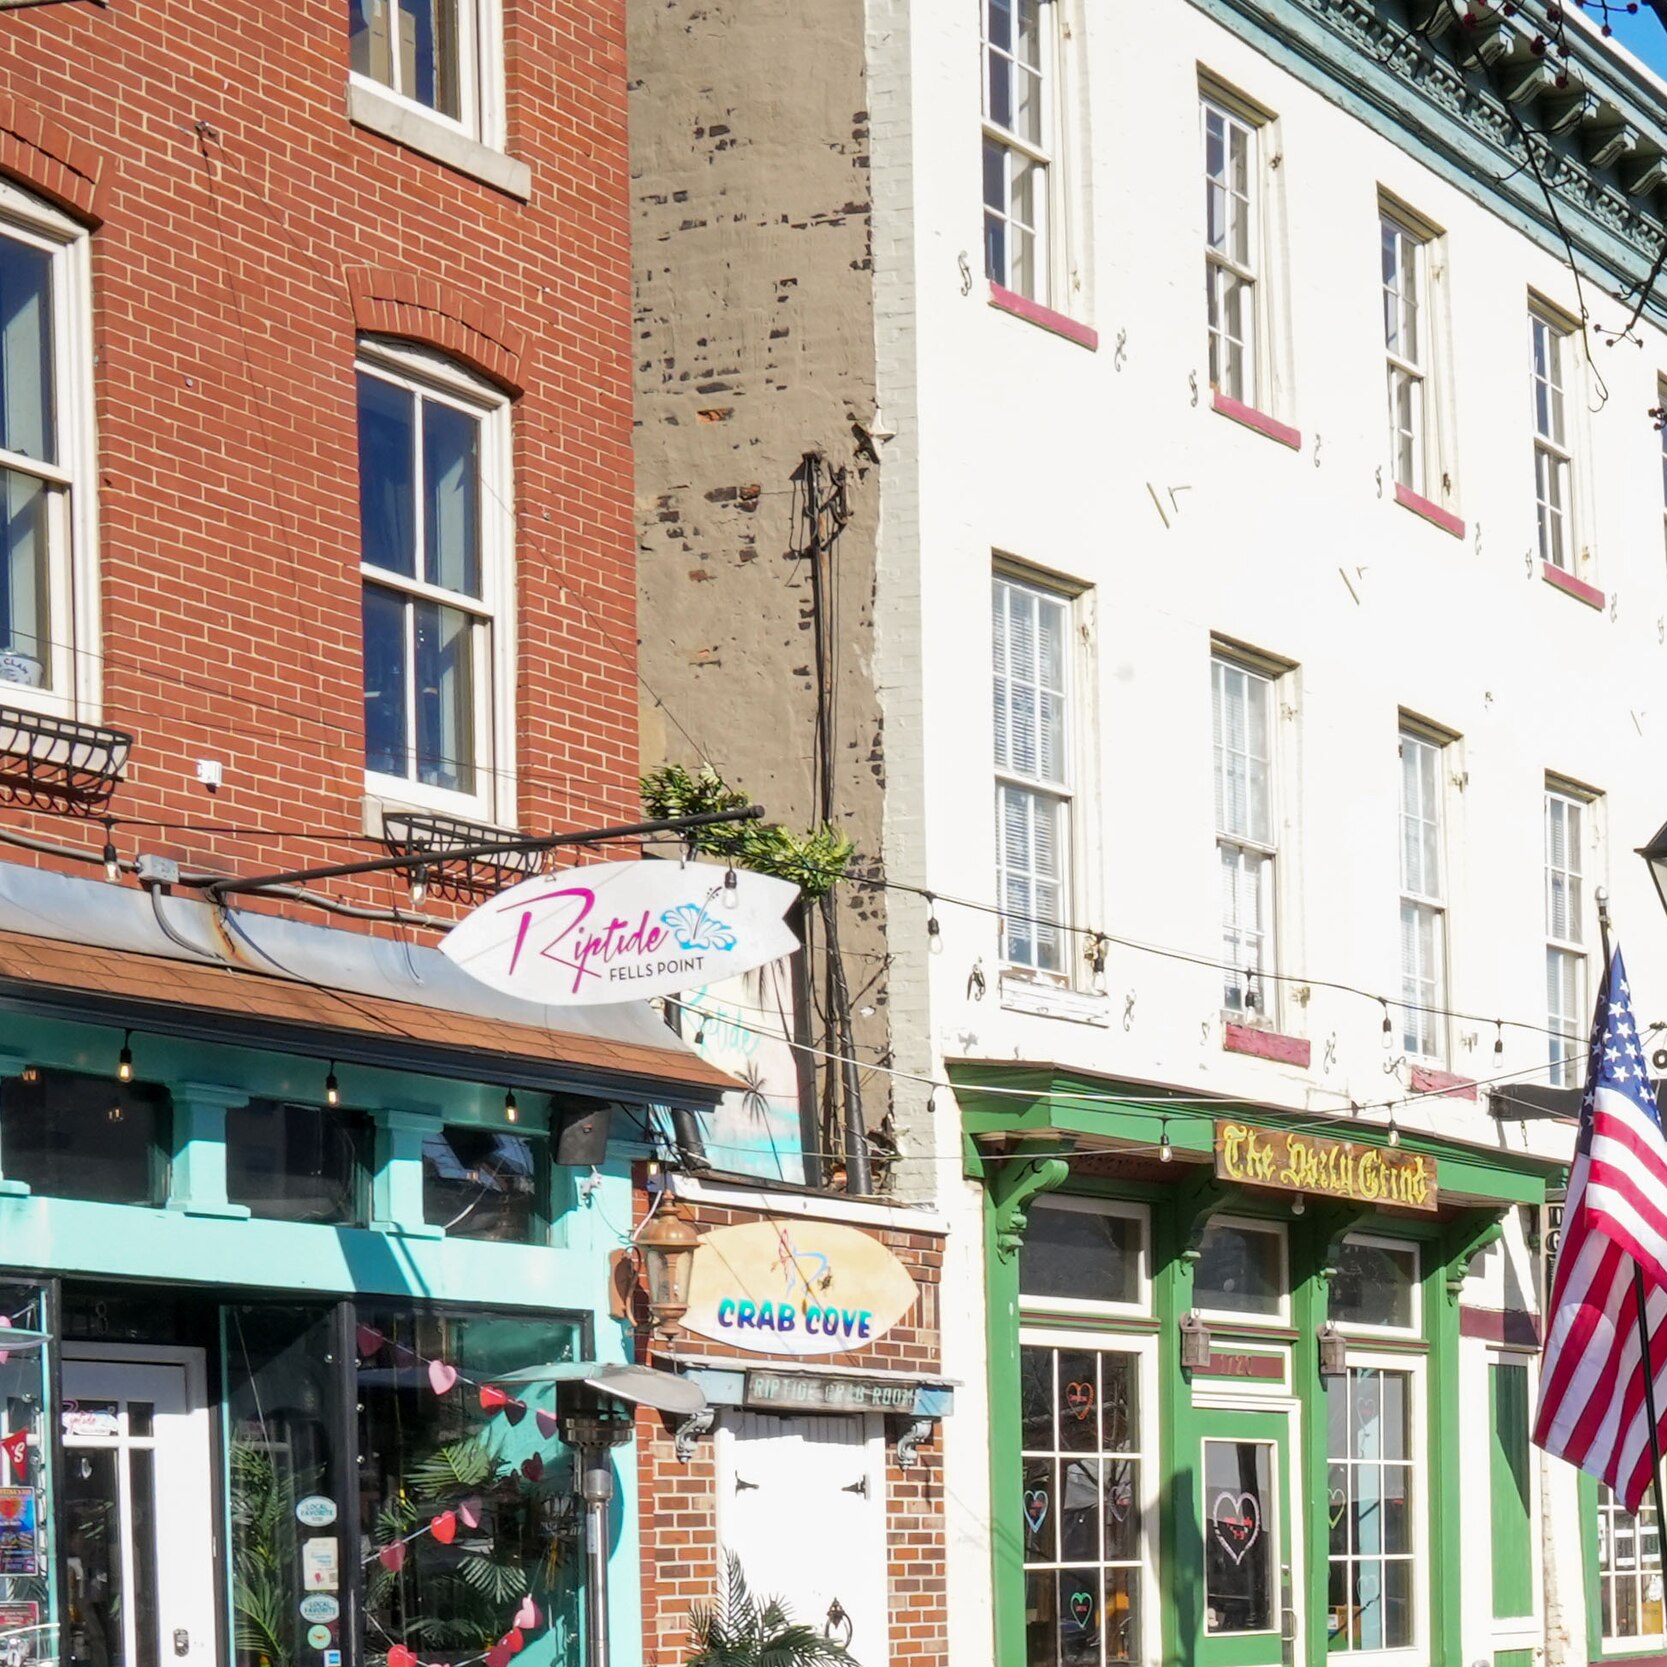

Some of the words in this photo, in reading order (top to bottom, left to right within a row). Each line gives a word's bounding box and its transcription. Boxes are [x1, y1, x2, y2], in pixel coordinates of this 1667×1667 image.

[496, 887, 669, 994] Riptide
[610, 964, 653, 982] FELLS
[658, 957, 704, 976] POINT
[1223, 1125, 1276, 1180] The
[1280, 1133, 1353, 1197] Daily
[1358, 1150, 1428, 1204] Grind
[718, 1298, 795, 1332] CRAB
[804, 1305, 873, 1339] COVE
[753, 1378, 816, 1401] RIPTIDE
[872, 1388, 914, 1406] ROOM
